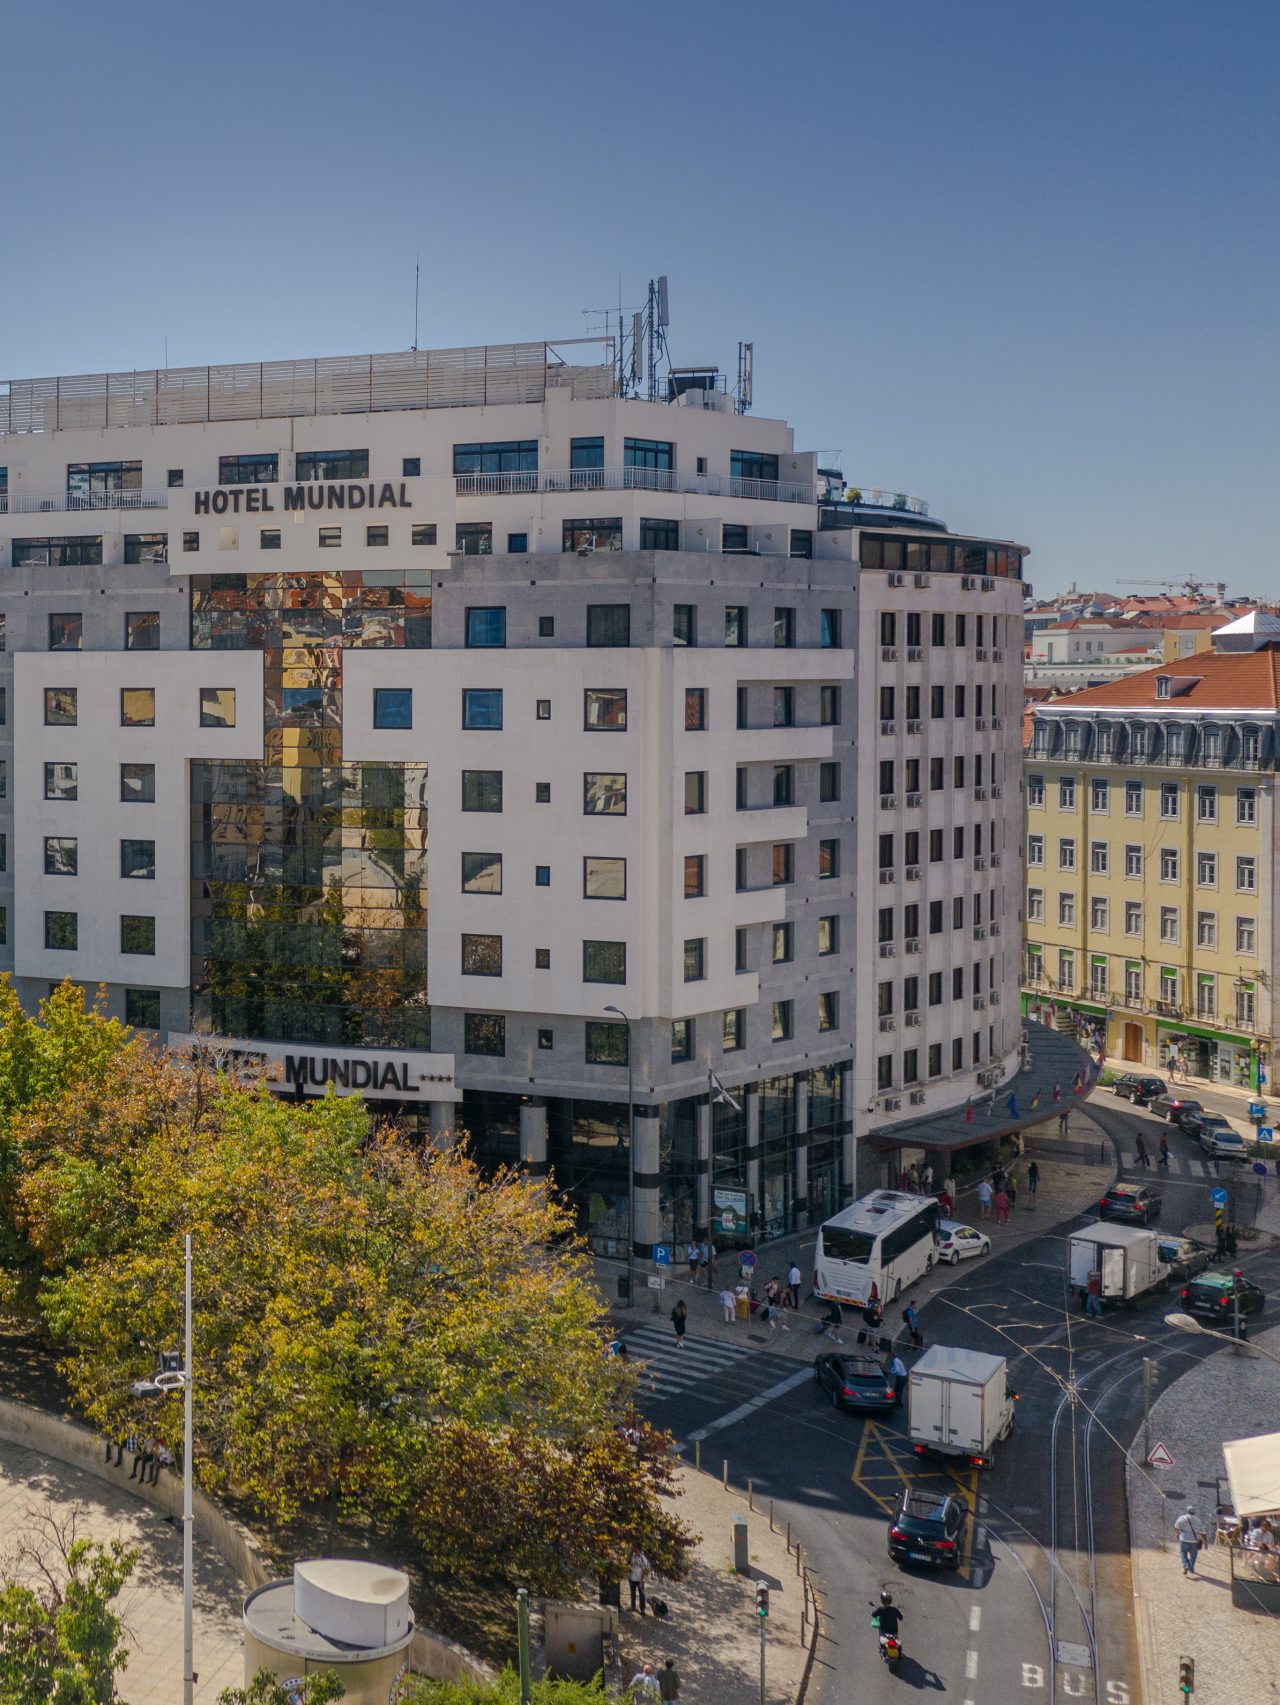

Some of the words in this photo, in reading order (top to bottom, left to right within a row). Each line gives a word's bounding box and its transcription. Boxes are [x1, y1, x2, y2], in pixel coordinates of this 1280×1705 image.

[194, 488, 274, 515] HOTEL
[283, 483, 413, 511] MUNDIAL
[285, 1055, 420, 1092] MUNDIAL
[657, 1247, 666, 1260] P
[1022, 1662, 1130, 1705] BUS
